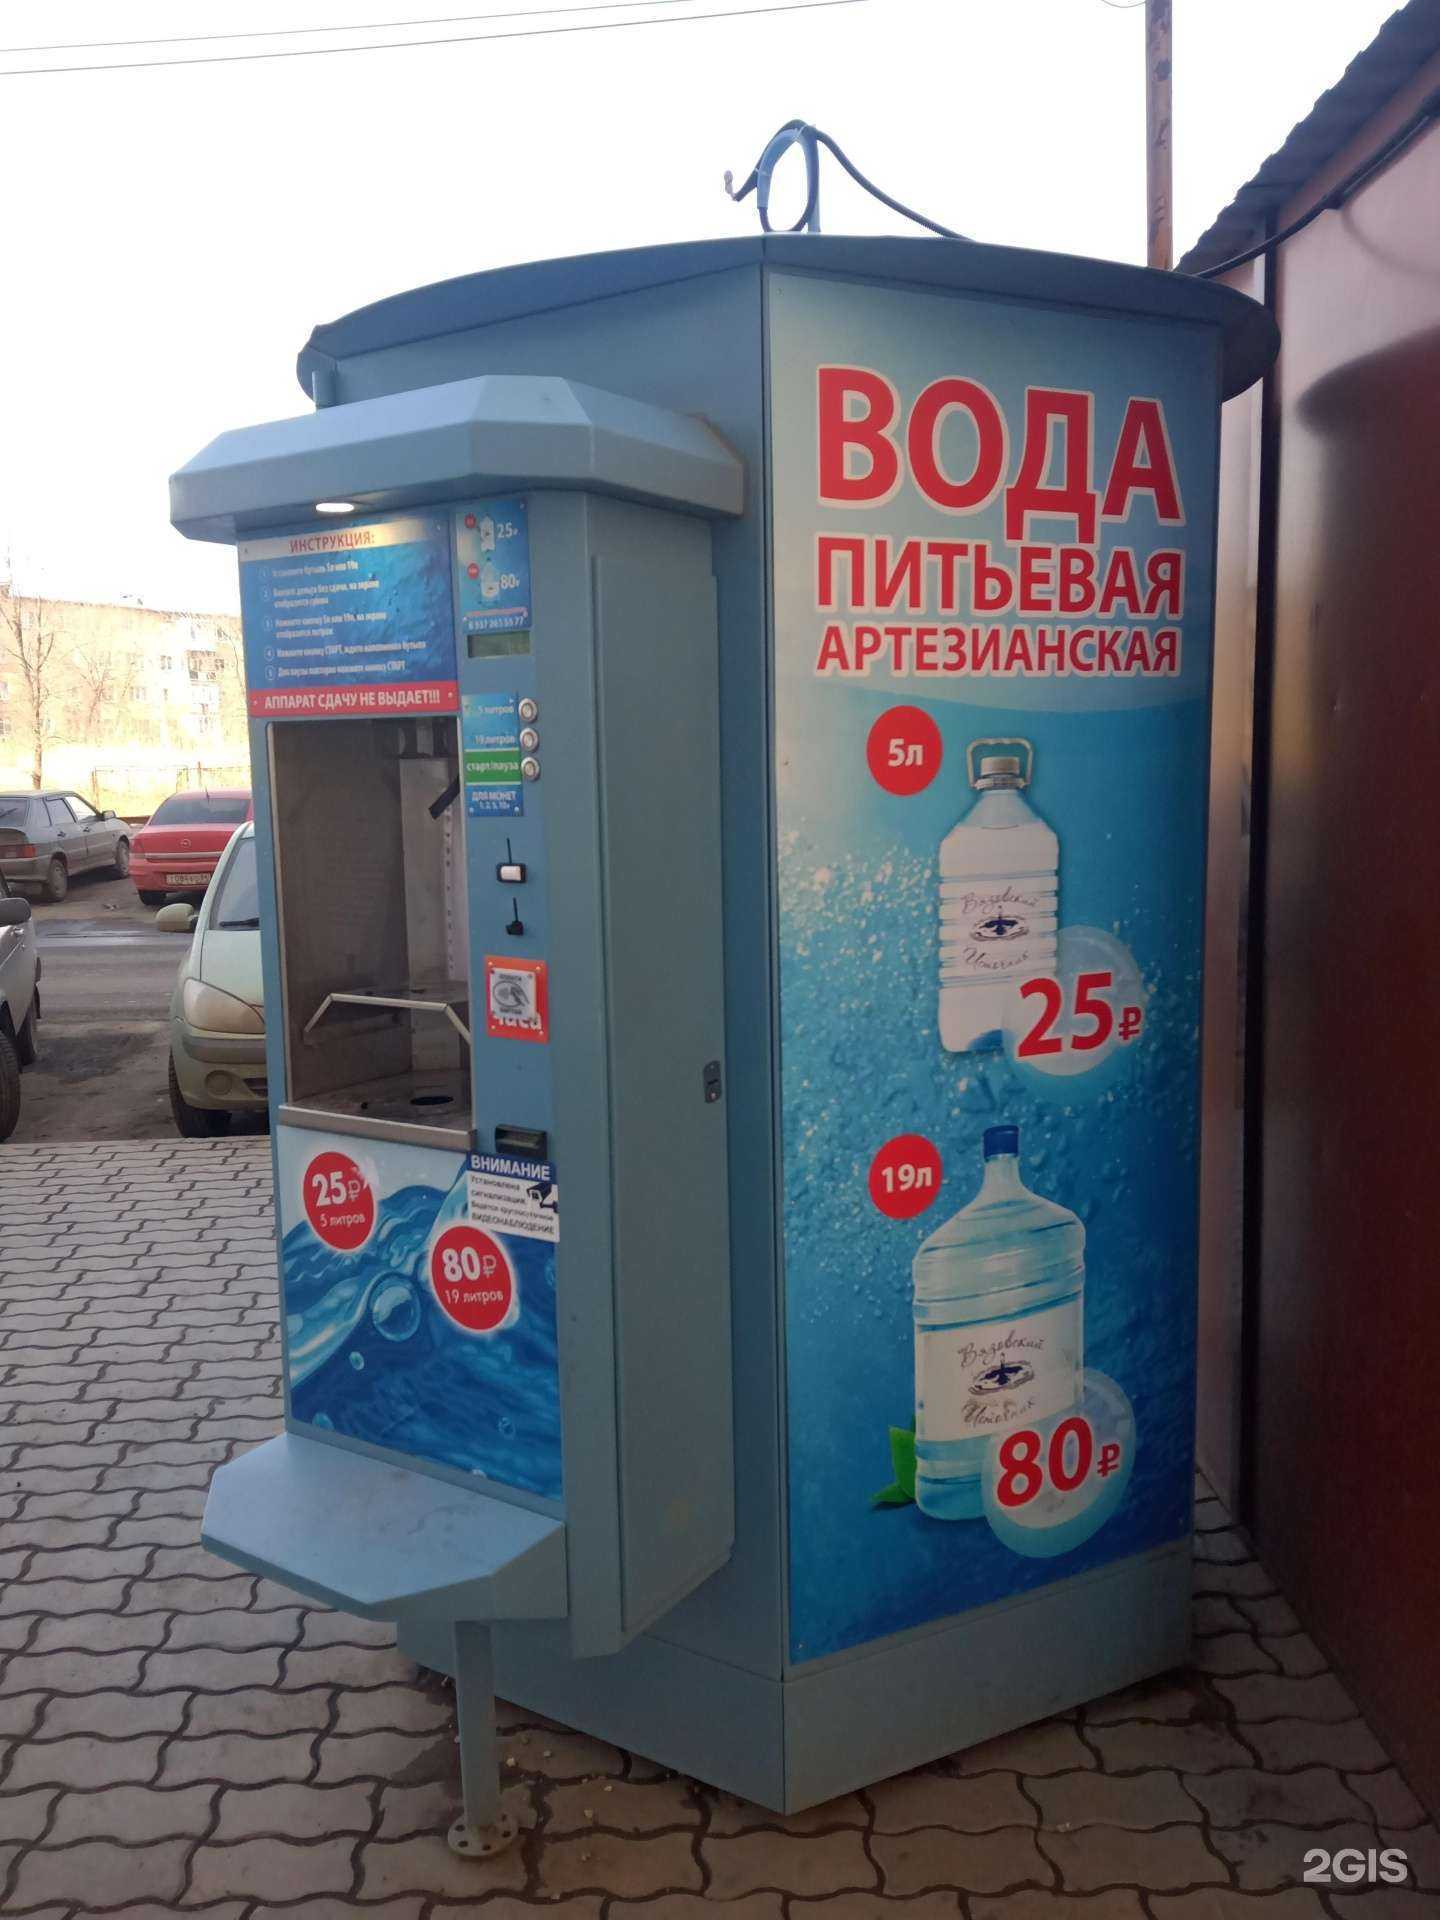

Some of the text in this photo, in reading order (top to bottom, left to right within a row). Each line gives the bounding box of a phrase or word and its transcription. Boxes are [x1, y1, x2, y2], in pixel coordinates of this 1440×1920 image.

[816, 366, 1184, 545] ВОДА
[289, 531, 375, 553] ИНСТРУКЦИЯ:
[815, 535, 1183, 616] ПИТЬЕВАЯ
[816, 624, 1179, 673] АРТЕЗИАНСКАЯ
[265, 689, 440, 709] АППАРАТ СДАЧУ НЕ ВЫДАЕТ!!!
[886, 738, 924, 767] 5л
[471, 1154, 551, 1181] ВНИМАНИЕ
[881, 1162, 933, 1194] 19л
[319, 1213, 367, 1228] 5 литров
[445, 1289, 504, 1306] 19 литров
